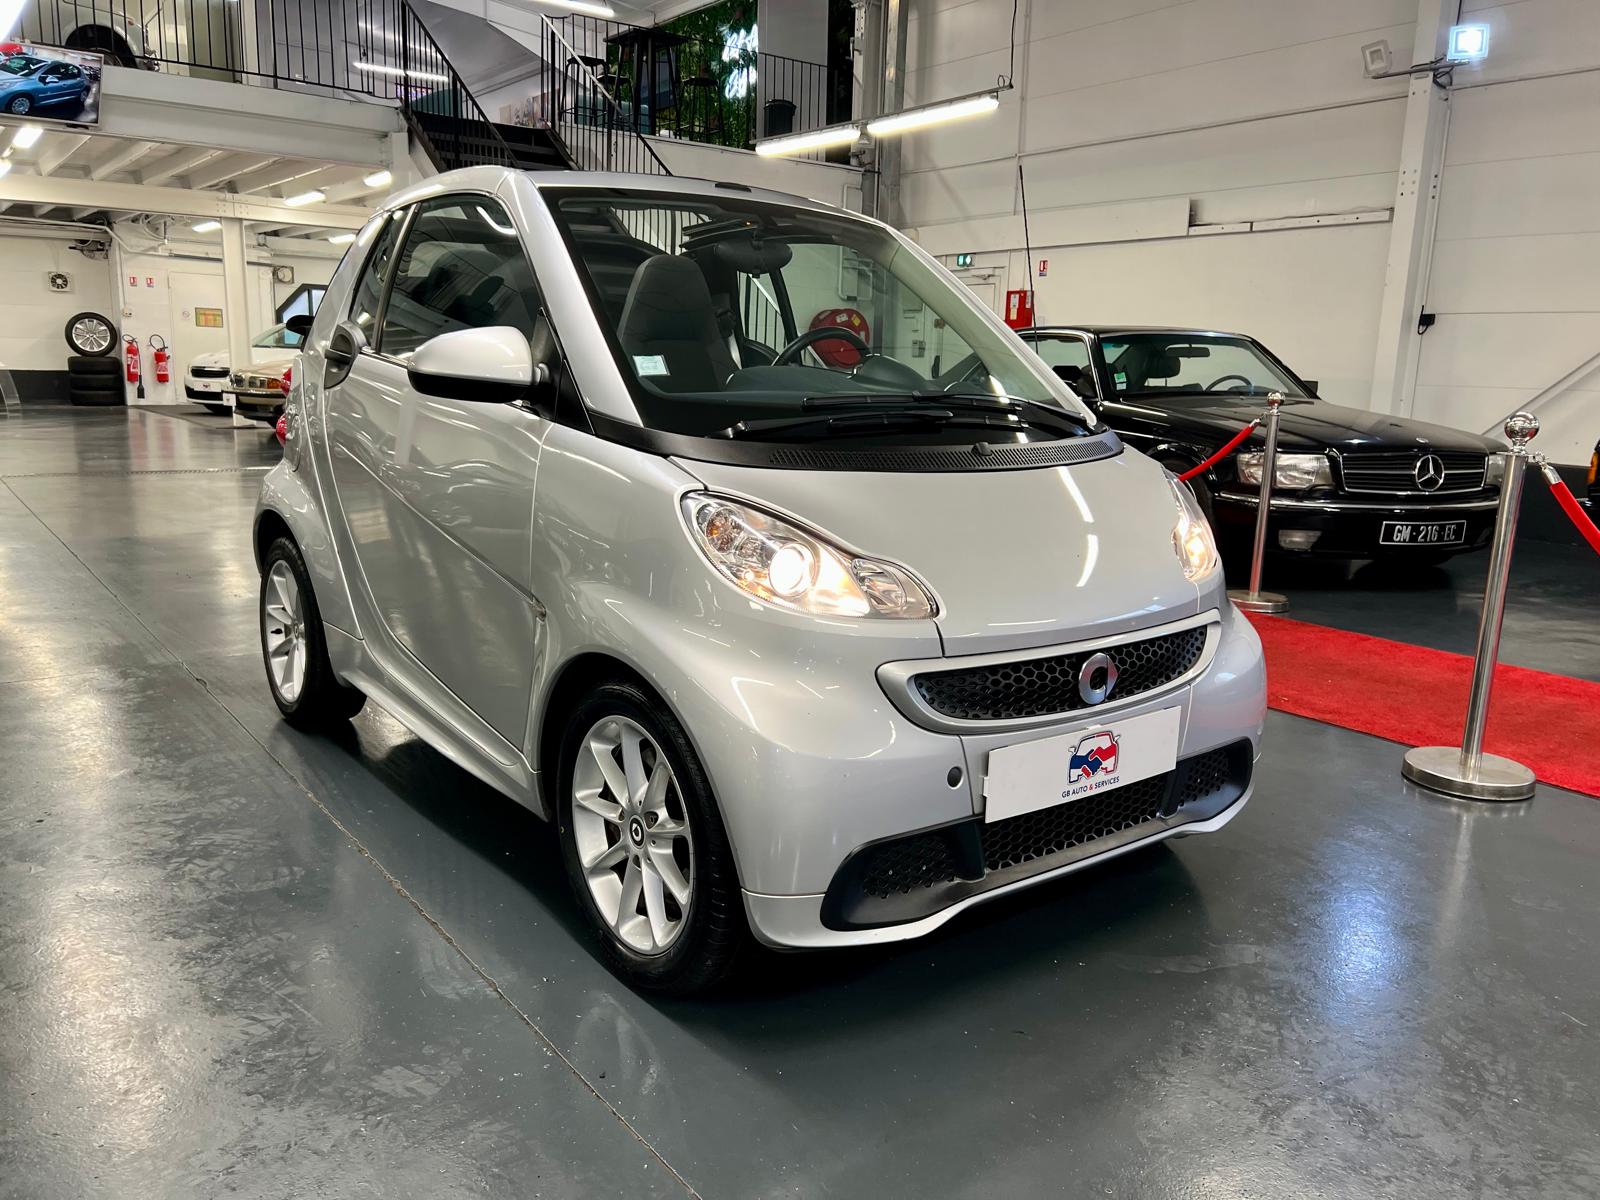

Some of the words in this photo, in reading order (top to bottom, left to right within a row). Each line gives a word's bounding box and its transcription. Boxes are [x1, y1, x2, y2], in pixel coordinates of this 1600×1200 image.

[1061, 790, 1071, 798] GB
[1071, 785, 1088, 795] AUTO
[1094, 776, 1120, 789] SERVICES
